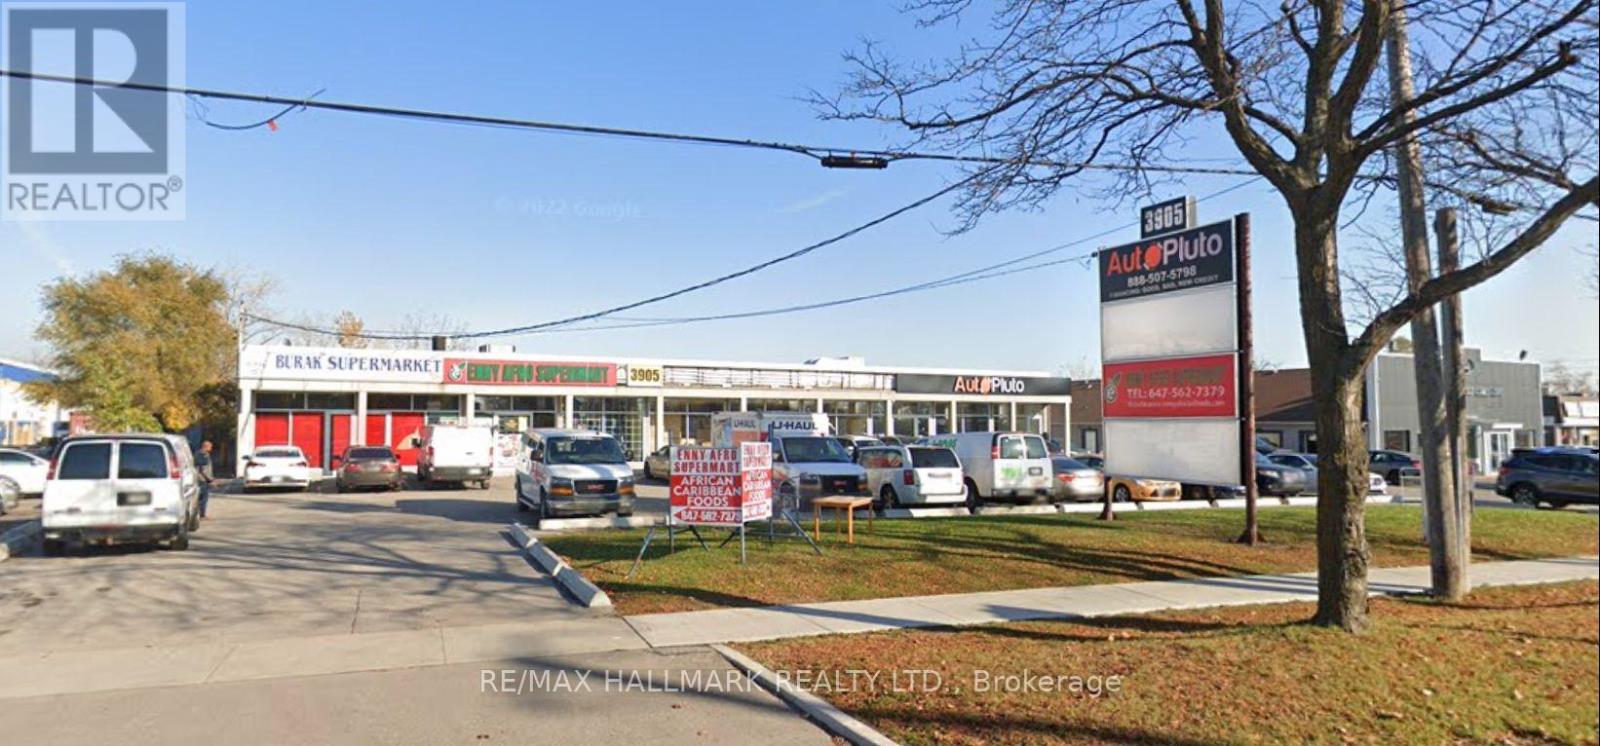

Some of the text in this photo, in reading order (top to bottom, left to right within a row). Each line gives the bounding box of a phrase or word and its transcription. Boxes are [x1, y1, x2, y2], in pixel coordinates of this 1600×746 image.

[1144, 203, 1184, 232] 3905
[1127, 265, 1197, 287] 888-507-5798
[275, 354, 322, 369] BURAK
[327, 356, 441, 373] SUPERMARKET
[630, 368, 660, 382] 3905
[676, 448, 705, 461] ENNY
[673, 461, 740, 473] SUPERMART
[680, 476, 734, 486] AFRICAN
[673, 485, 742, 497] CARIBBEAN
[687, 496, 729, 507] FOODS
